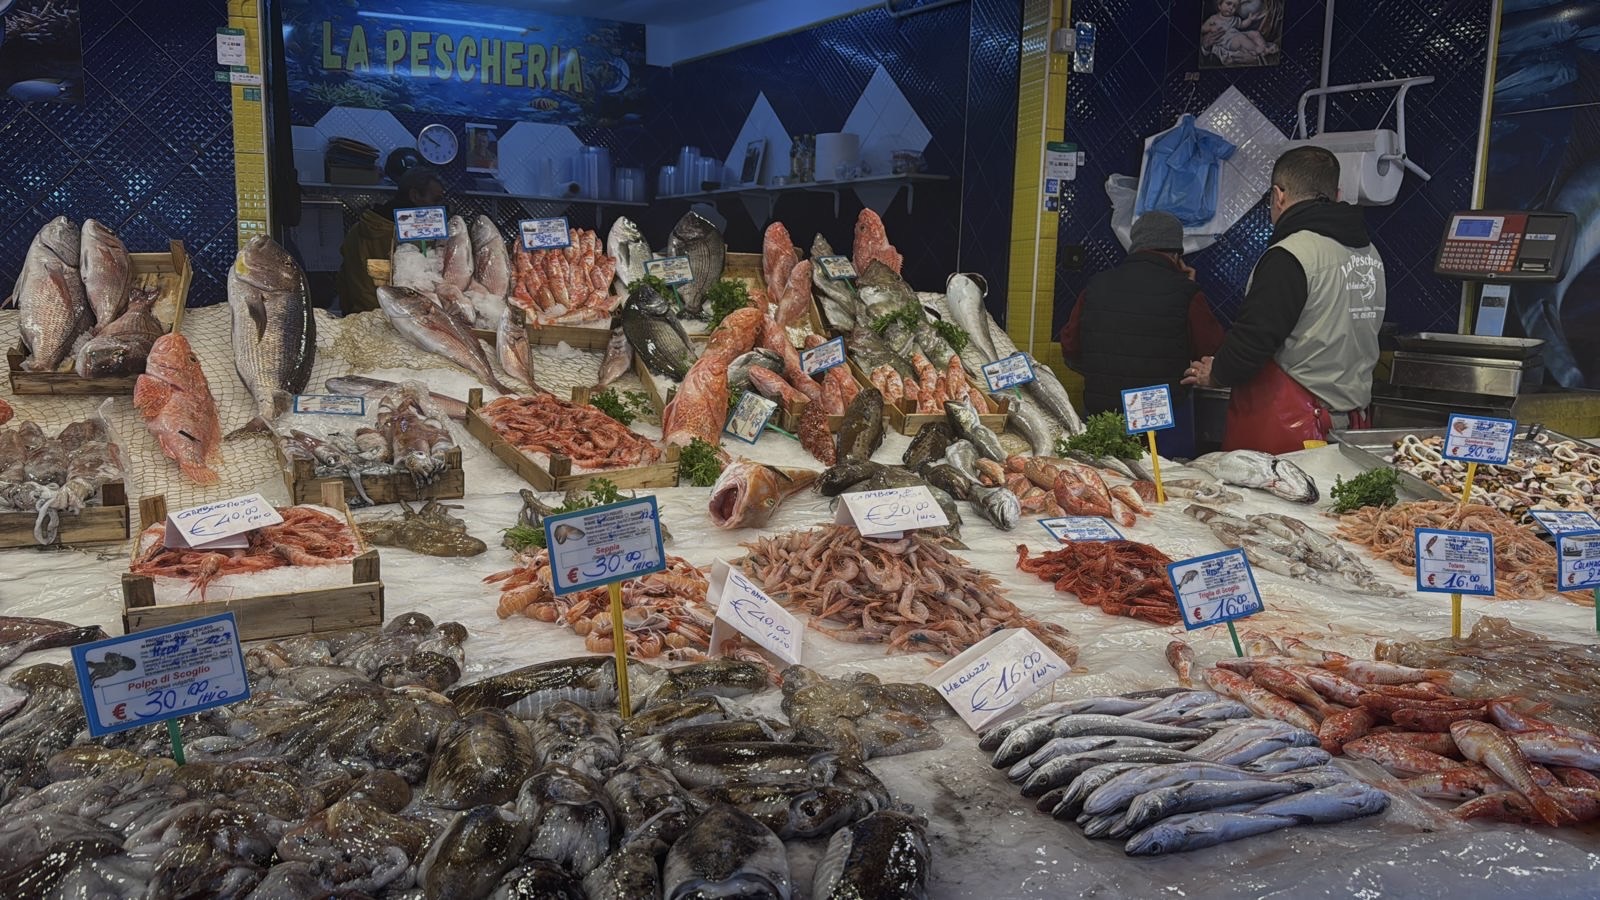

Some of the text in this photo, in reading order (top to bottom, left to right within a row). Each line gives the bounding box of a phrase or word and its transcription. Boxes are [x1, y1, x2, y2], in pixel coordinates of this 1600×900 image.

[322, 21, 584, 93] LA PESCHERIA
[595, 544, 620, 554] Seppia
[567, 566, 579, 583] €
[1427, 573, 1436, 585] €
[1193, 607, 1203, 620] €
[128, 665, 211, 691] Polpo di Scoglio
[112, 702, 127, 721] €
